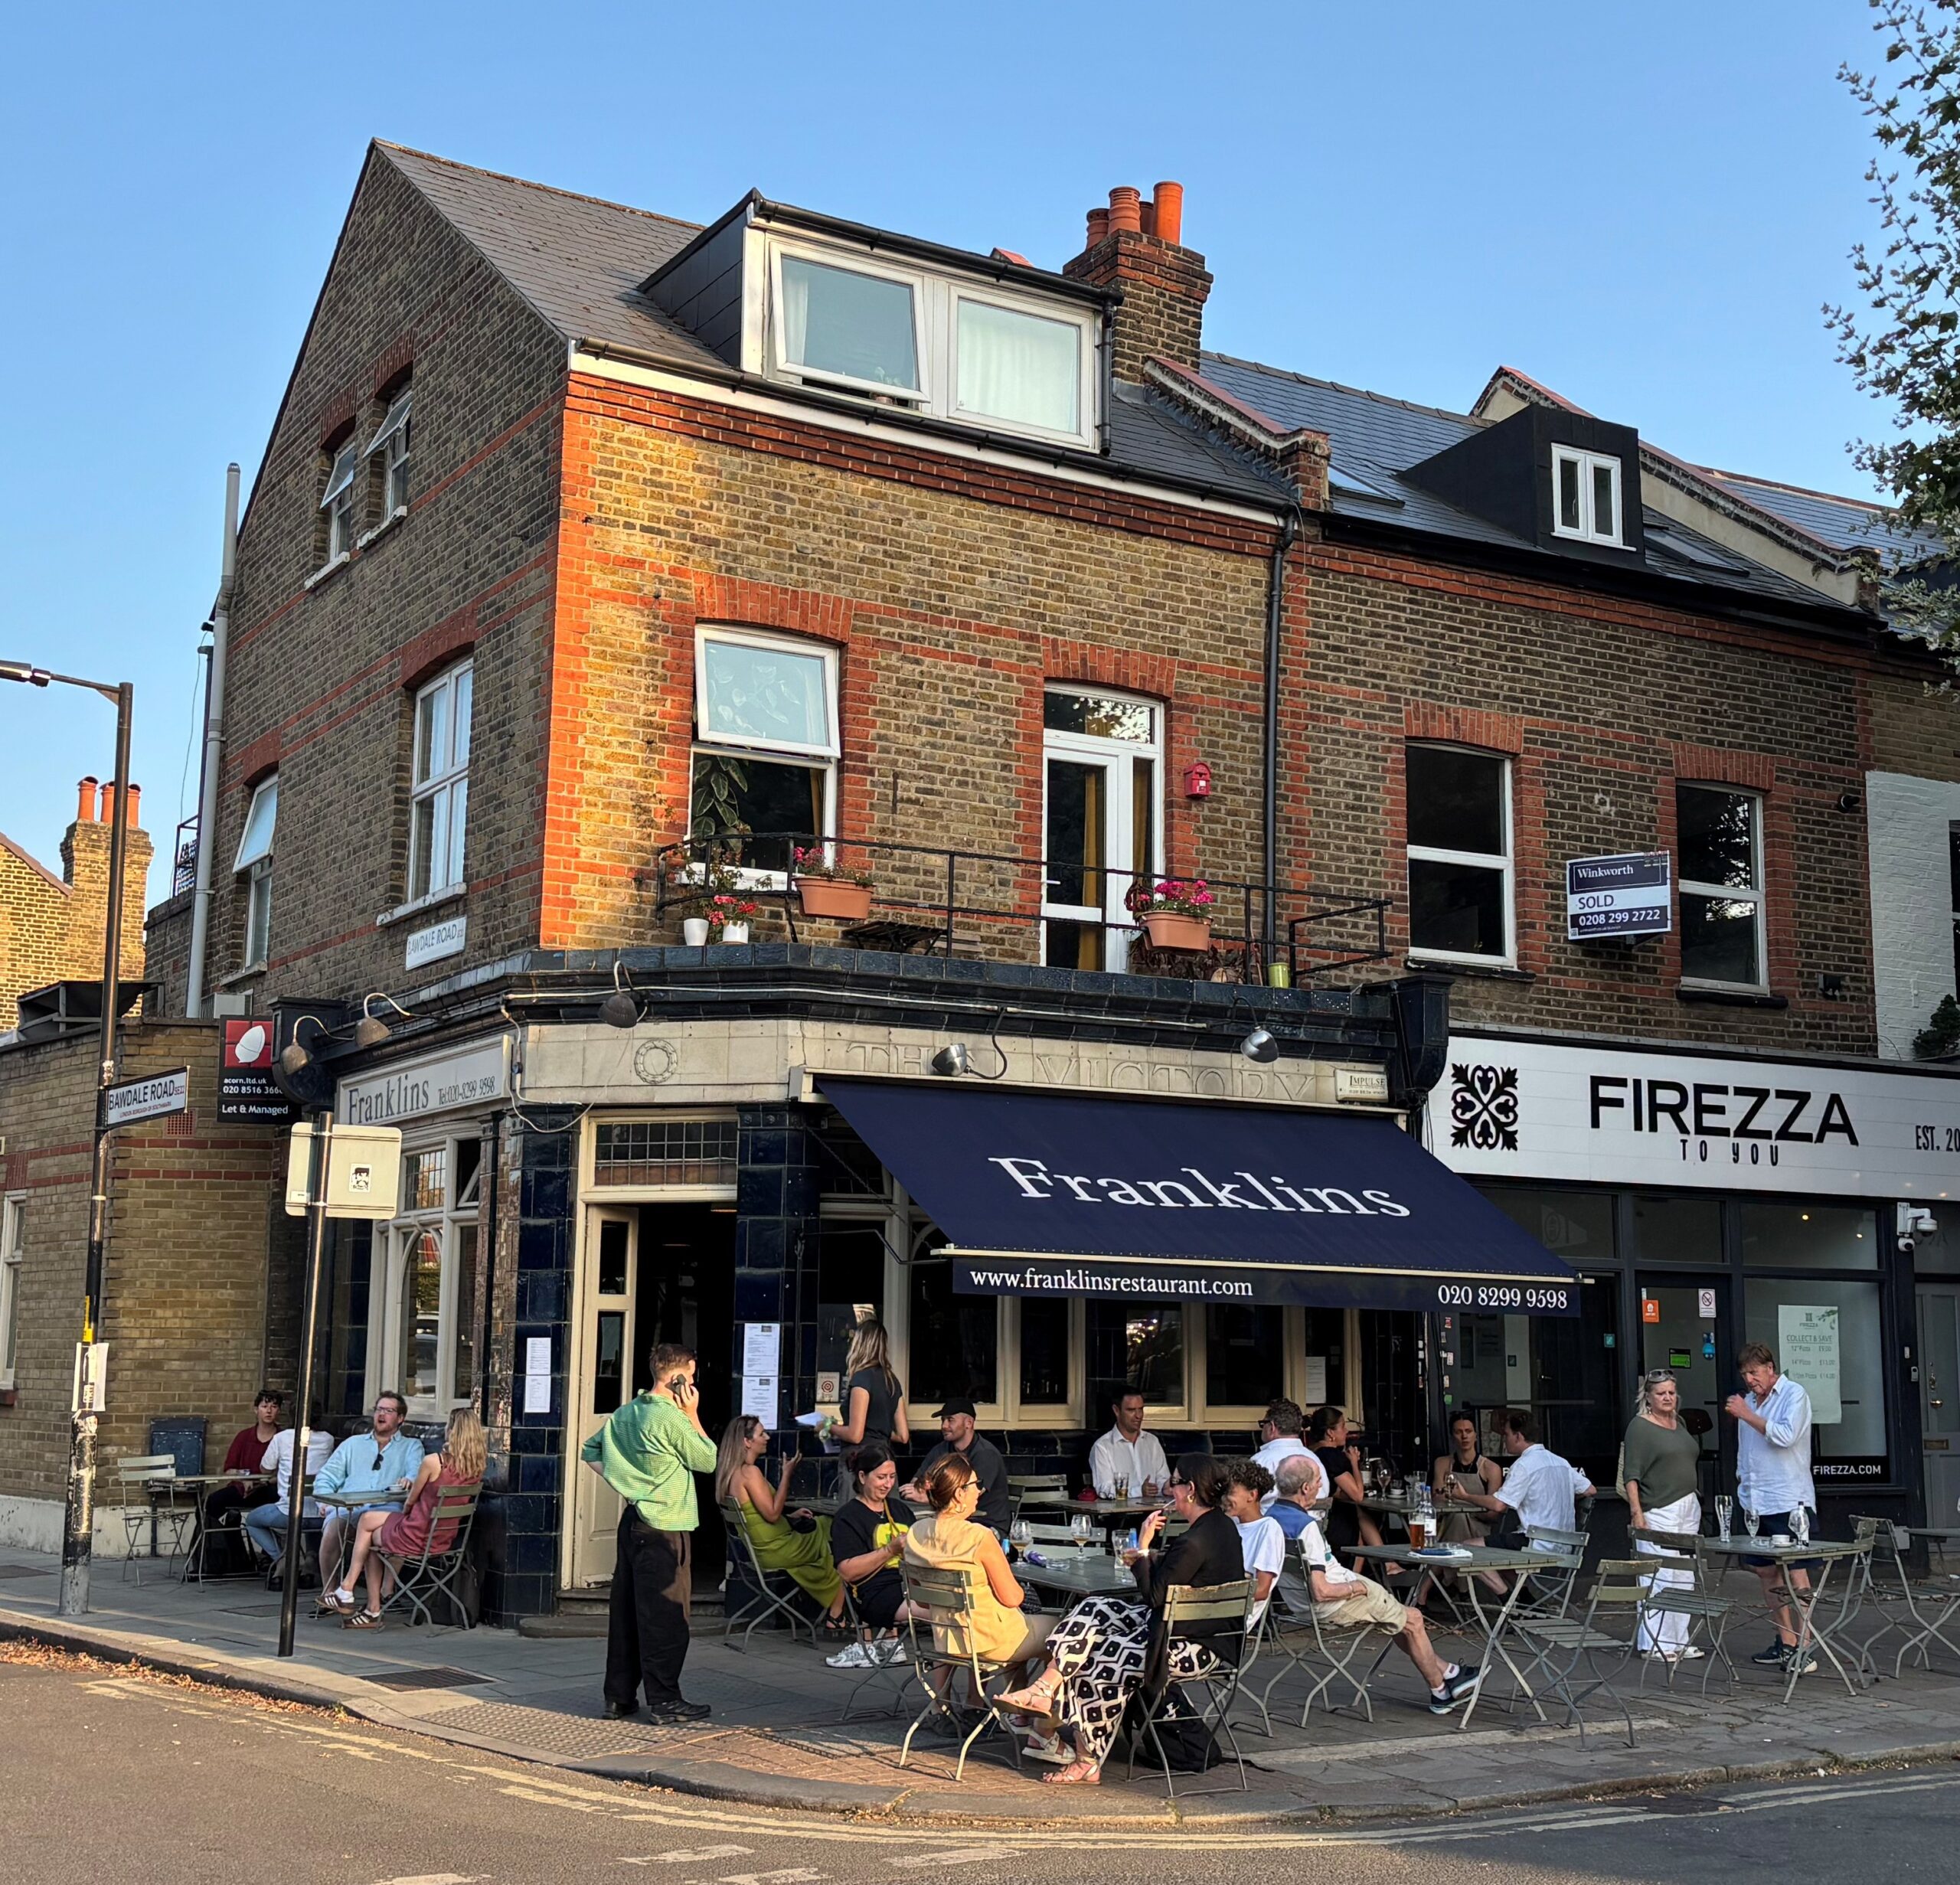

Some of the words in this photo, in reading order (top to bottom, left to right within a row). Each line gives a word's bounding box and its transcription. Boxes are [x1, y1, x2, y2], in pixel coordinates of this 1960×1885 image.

[1577, 864, 1634, 879] Winkworth
[1578, 894, 1615, 910] SOLD
[1579, 913, 1606, 926] 0208
[1608, 911, 1629, 923] 299
[1632, 909, 1661, 922] 2722
[436, 923, 457, 945] ROAD
[109, 1086, 149, 1110] BAWDALE
[150, 1080, 175, 1101] ROAD
[348, 1073, 430, 1125] Franklins
[479, 1076, 495, 1096] 9598
[222, 1104, 237, 1113] Let
[240, 1104, 247, 1113] &
[248, 1105, 289, 1116] Managed
[1589, 1075, 1860, 1147] FIREZZA
[1916, 1125, 1940, 1151] EST.
[1680, 1139, 1708, 1162] TO
[988, 1157, 1410, 1217] Franklins
[969, 1267, 1253, 1296] www.franklinsrestaurant.com
[1438, 1285, 1472, 1305] 020
[1478, 1286, 1521, 1307] 8299
[1526, 1289, 1567, 1309] 9598
[1813, 1465, 1881, 1475] FIREZZA.COM
